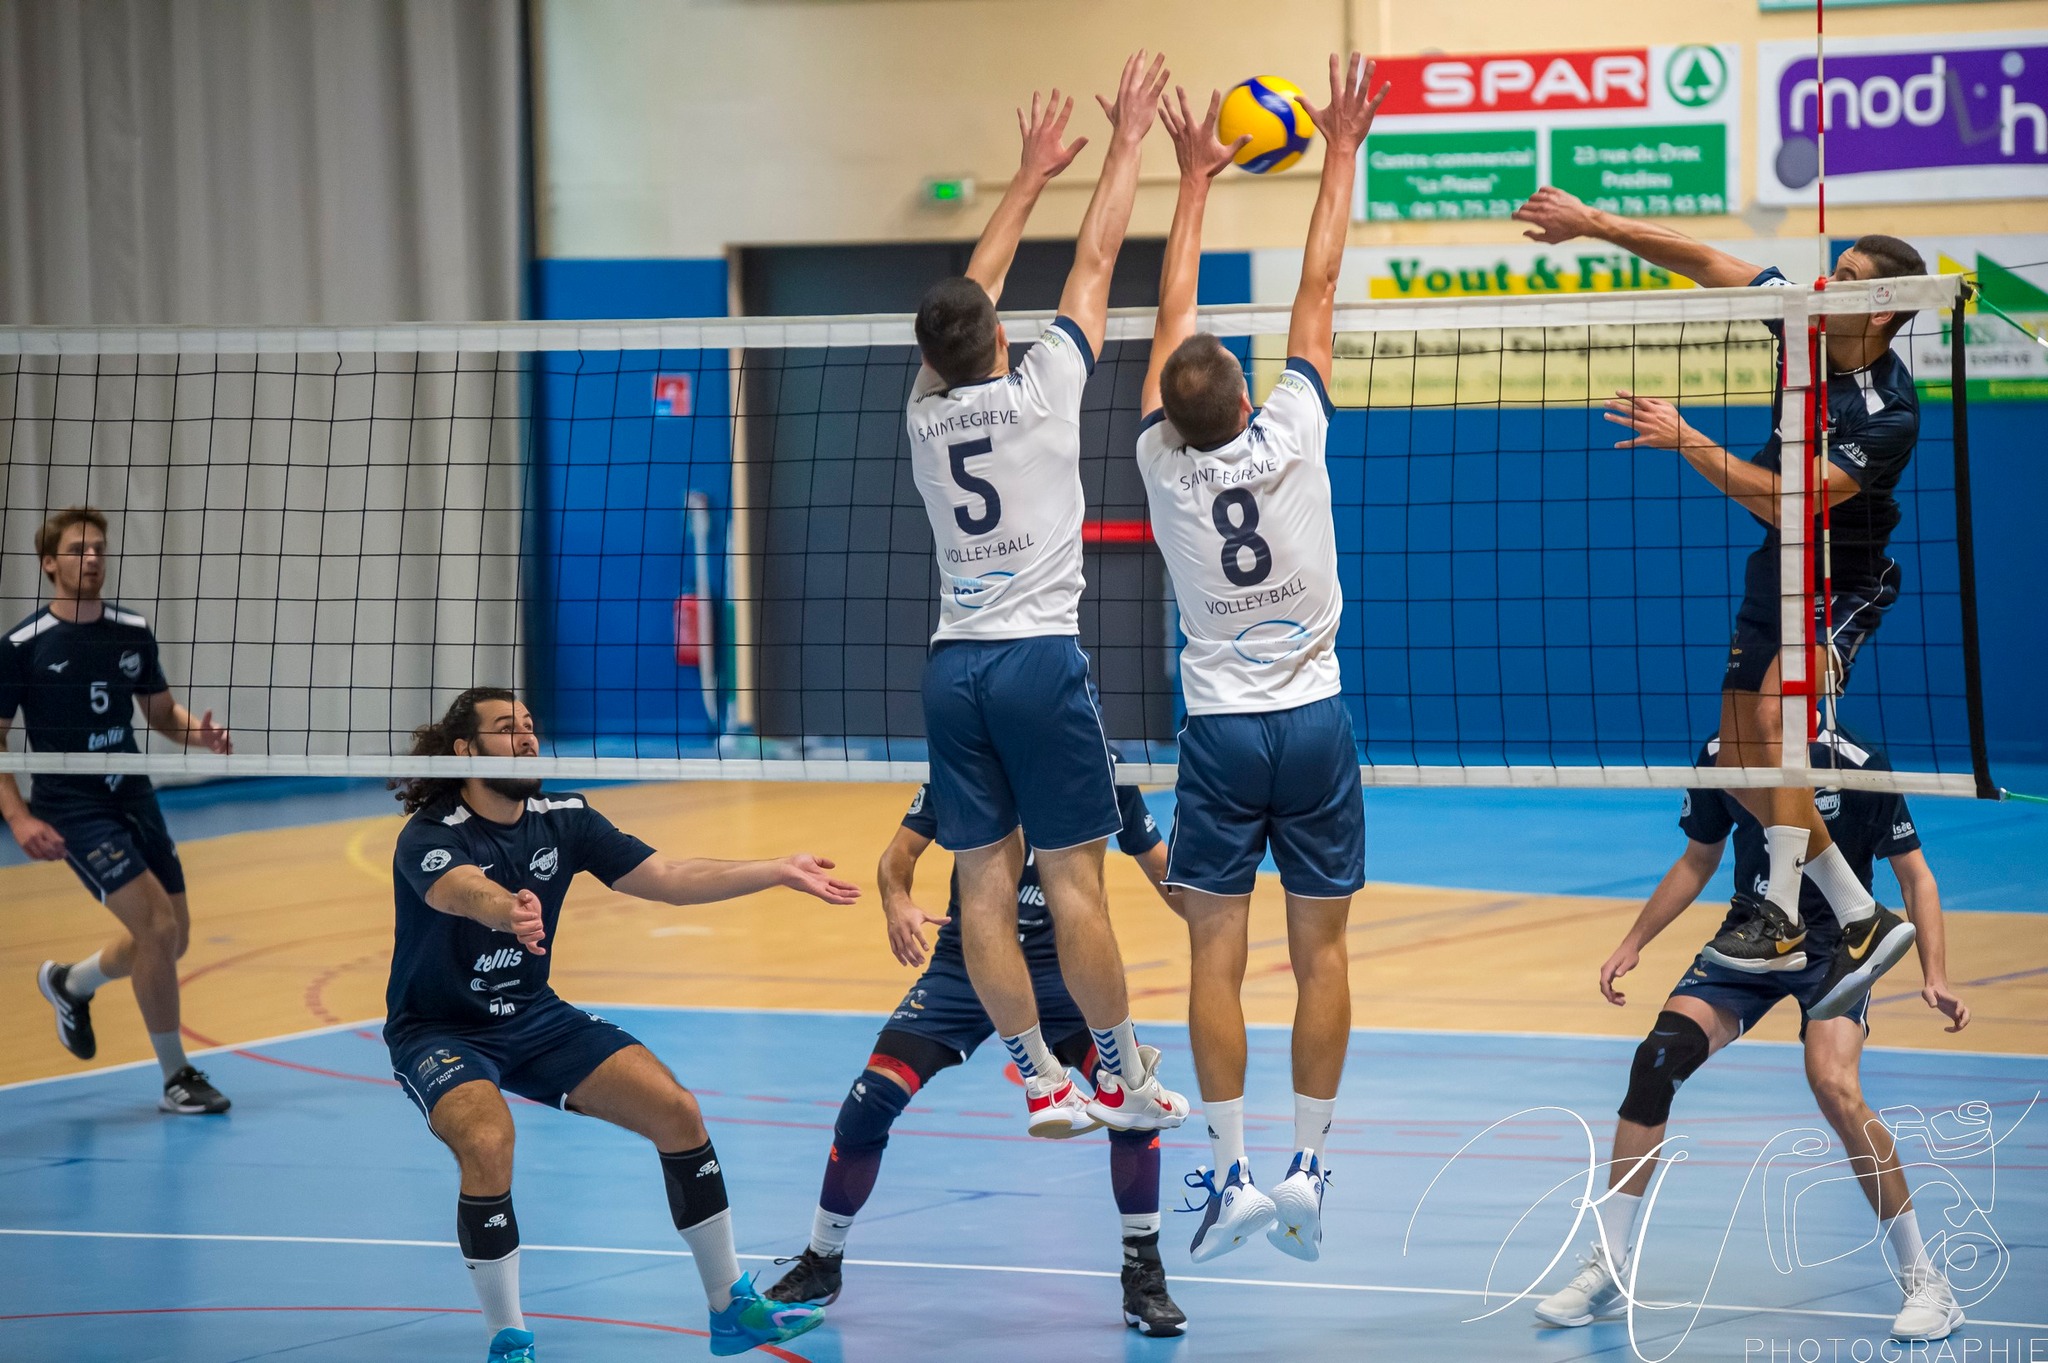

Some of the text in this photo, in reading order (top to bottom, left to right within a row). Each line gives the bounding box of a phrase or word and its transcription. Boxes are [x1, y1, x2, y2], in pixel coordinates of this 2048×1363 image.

[1422, 56, 1646, 107] SPAR
[1389, 254, 1671, 292] Vout & Fils
[918, 410, 1018, 442] SAINT-EGREVE
[948, 436, 1002, 536] 5
[1180, 458, 1277, 491] SANT-EGRVE
[943, 533, 1035, 563] VOLLEY-BALL
[1212, 487, 1272, 587] 8
[1204, 578, 1307, 615] VOLLEY-BALL
[90, 681, 109, 714] 5
[473, 947, 523, 973] tellis
